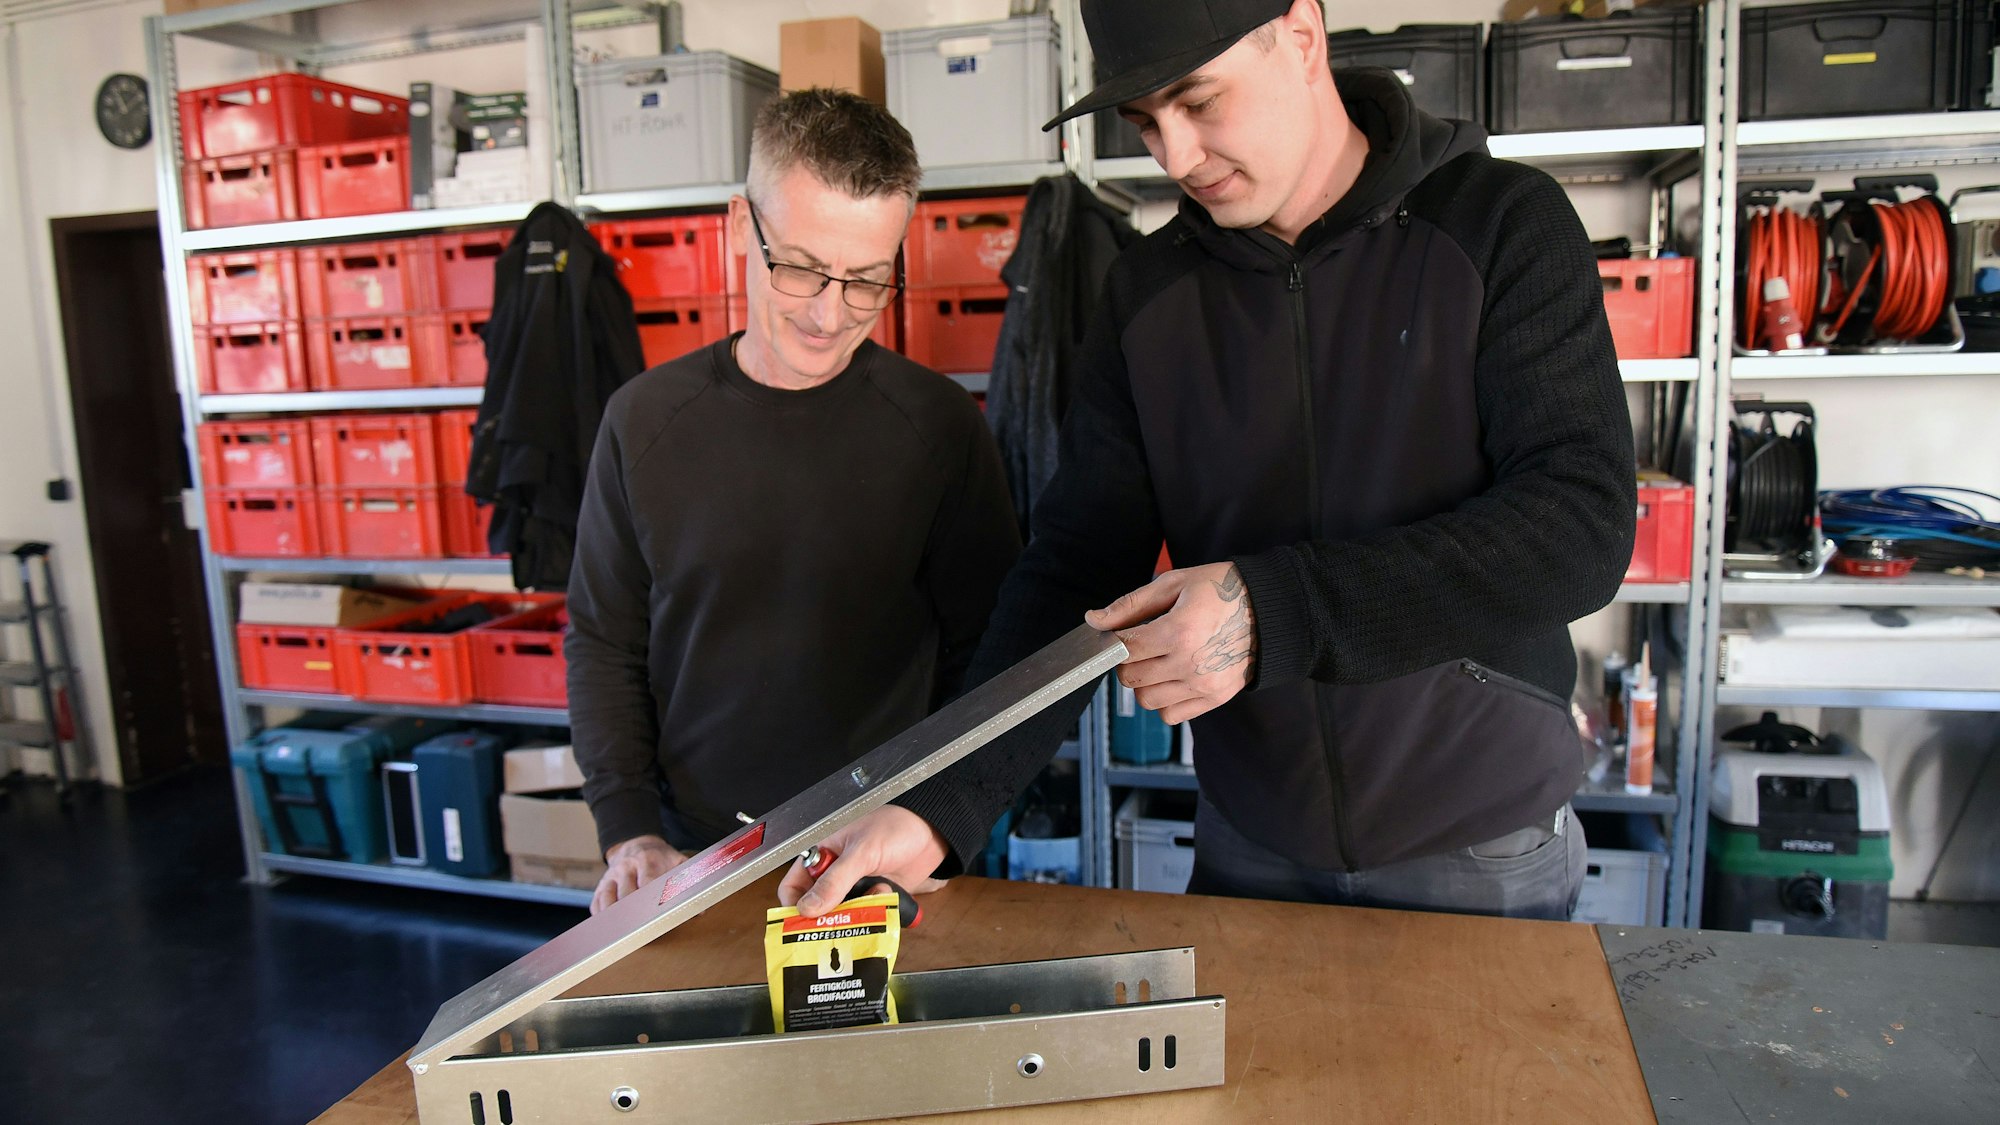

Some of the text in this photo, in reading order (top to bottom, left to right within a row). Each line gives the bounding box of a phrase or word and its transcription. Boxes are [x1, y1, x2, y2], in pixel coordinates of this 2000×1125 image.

[1782, 840, 1834, 852] HITACHI
[817, 914, 850, 926] Detia
[797, 927, 871, 941] PROFESSIONAL
[809, 979, 862, 994] FERTIGKÖDER
[807, 989, 865, 1004] BRODIFACOUM
